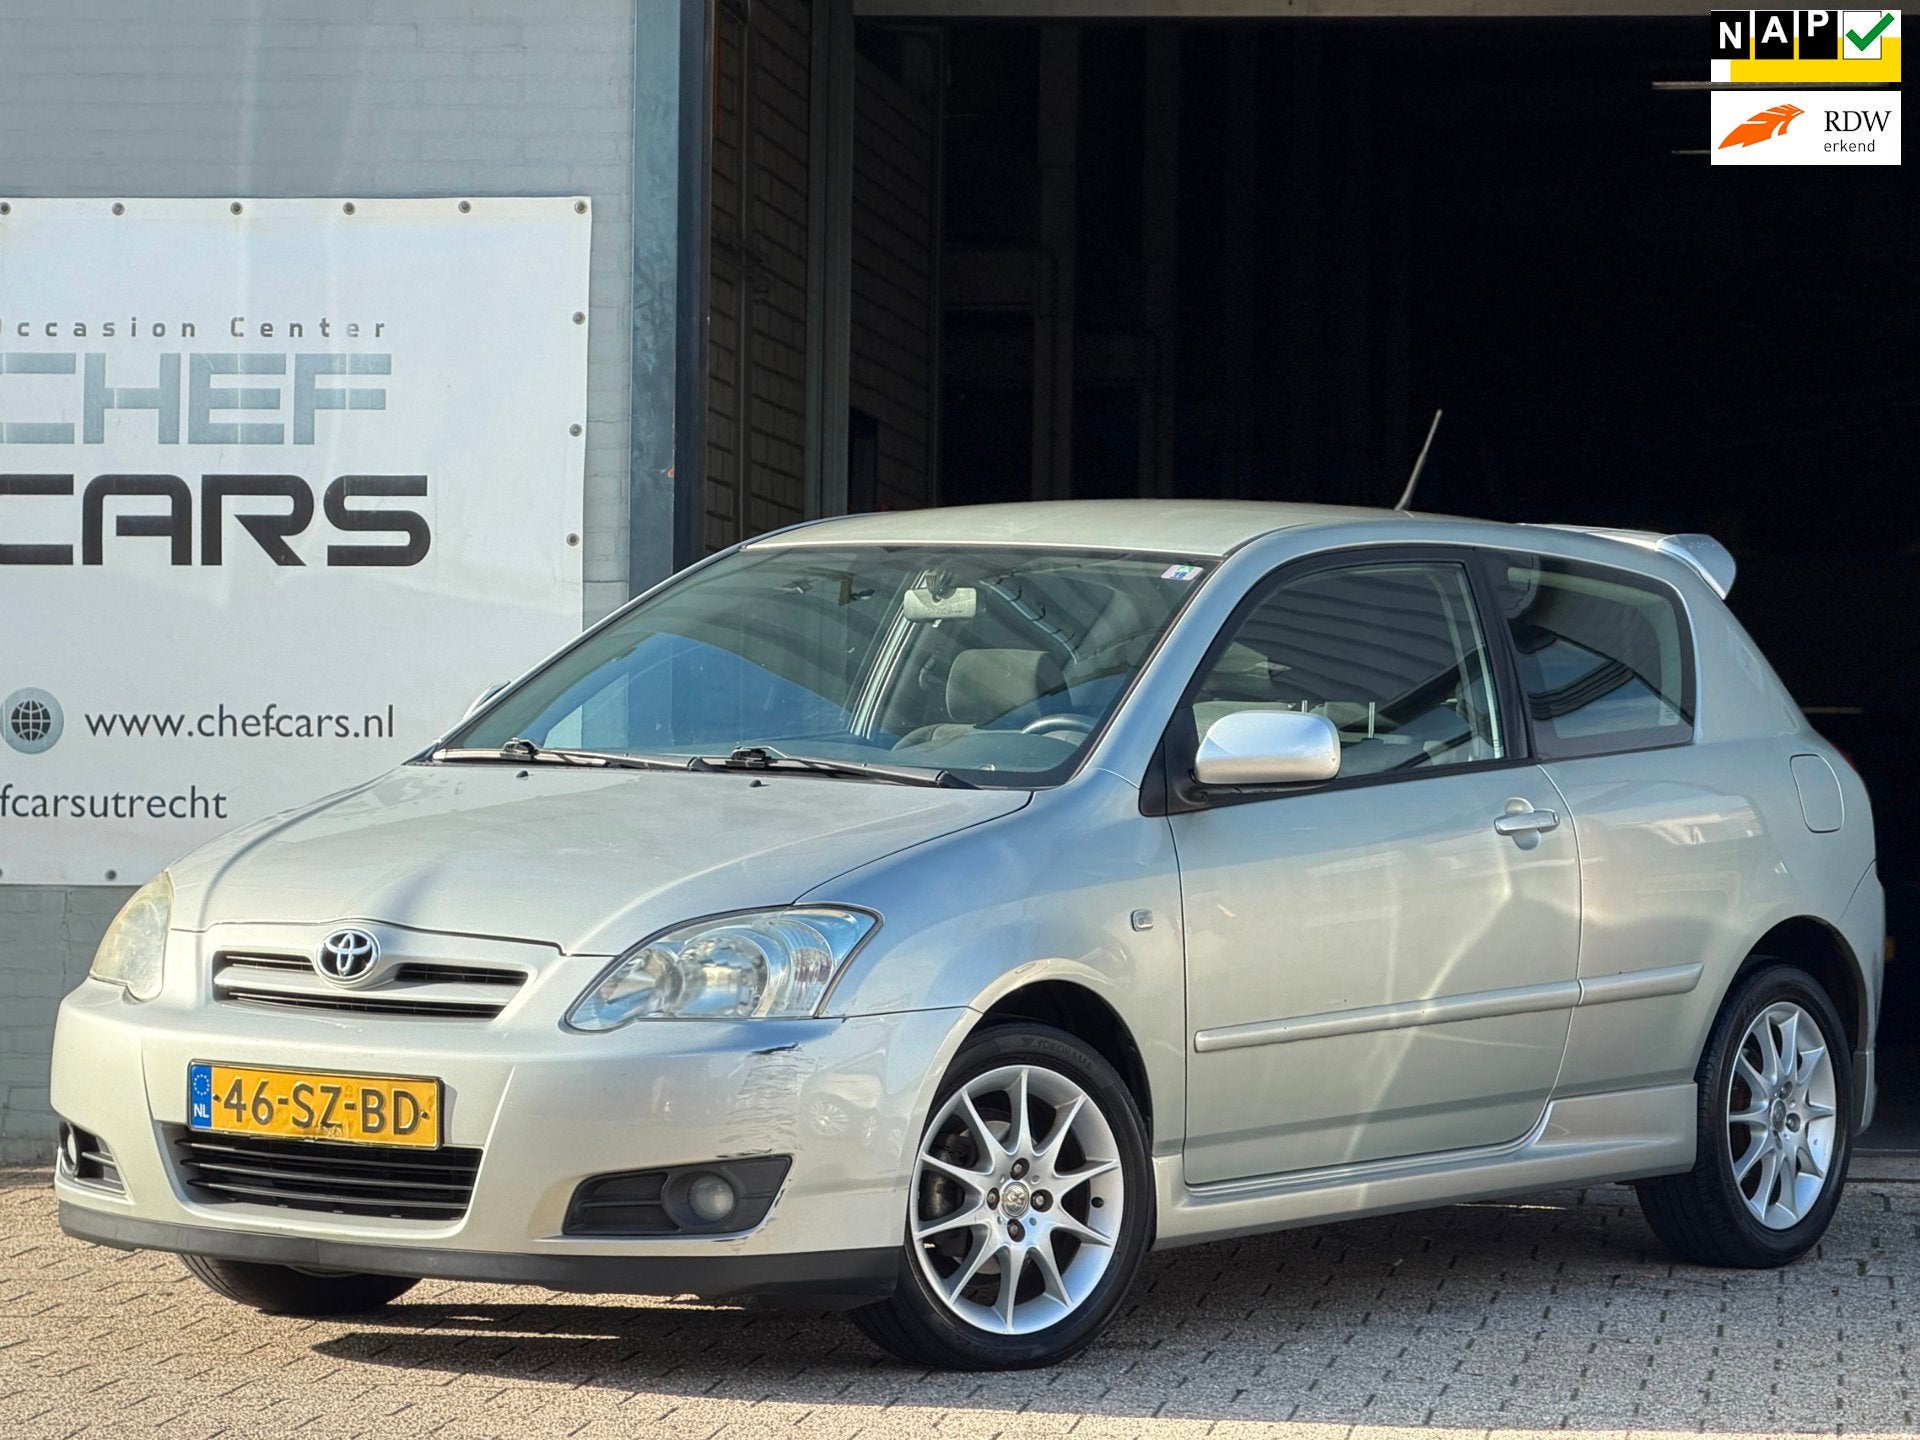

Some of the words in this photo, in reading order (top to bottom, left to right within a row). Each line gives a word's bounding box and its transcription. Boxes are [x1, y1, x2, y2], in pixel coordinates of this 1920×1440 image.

[0, 317, 196, 338] ccasion
[230, 317, 387, 338] Center
[0, 353, 391, 444] CHEF
[0, 474, 431, 566] CARS
[85, 704, 394, 738] www.chefcars.nl
[194, 1104, 210, 1119] NL
[223, 1077, 421, 1135] 46-SZ-BD
